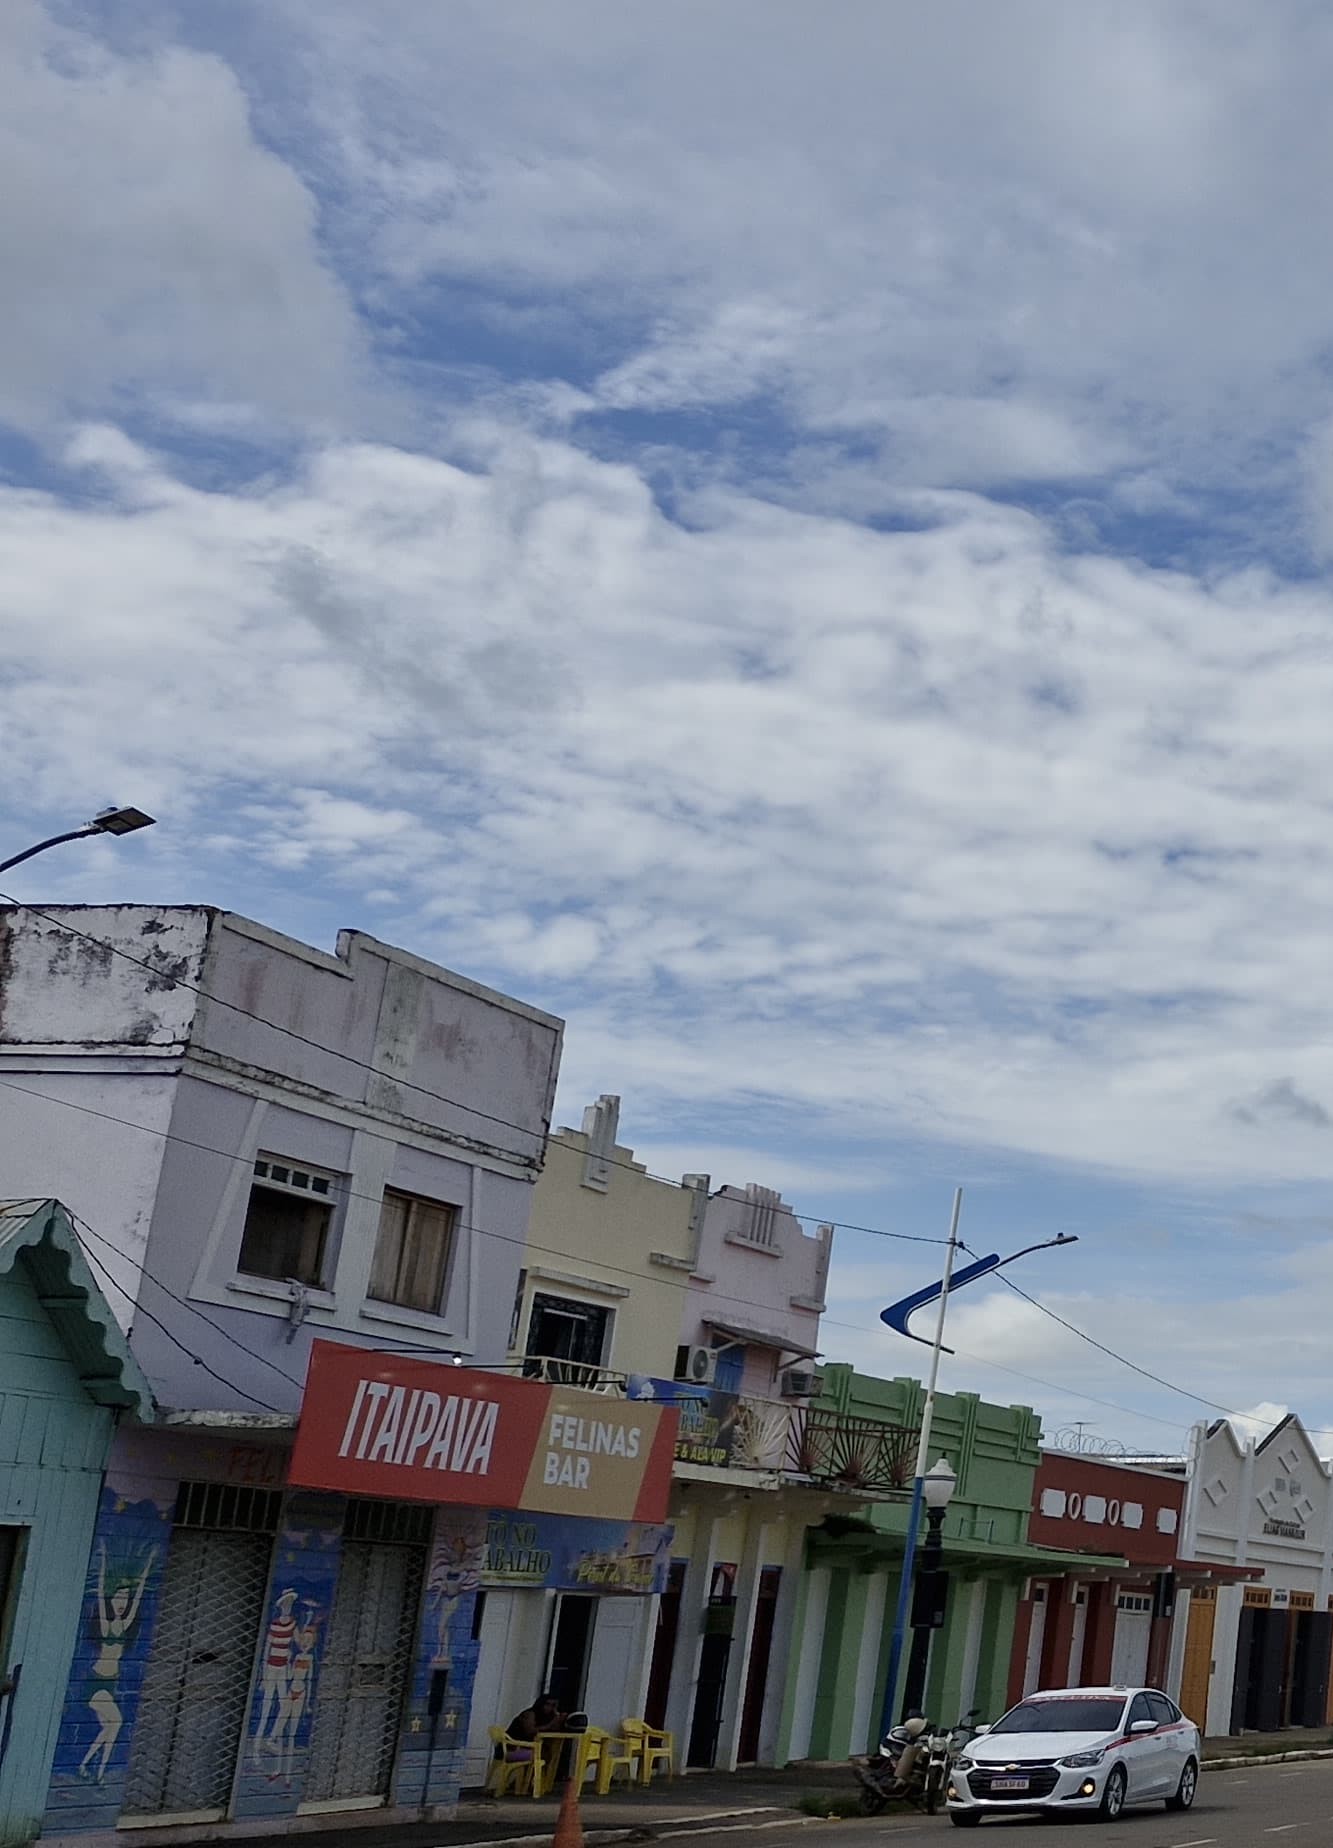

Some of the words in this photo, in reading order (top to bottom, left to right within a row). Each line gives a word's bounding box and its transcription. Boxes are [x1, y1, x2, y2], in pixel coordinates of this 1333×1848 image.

[338, 1379, 499, 1475] ITAIPAVA
[548, 1413, 641, 1459] FELINAS
[543, 1451, 590, 1489] BAR
[480, 1548, 552, 1574] ABALHO
